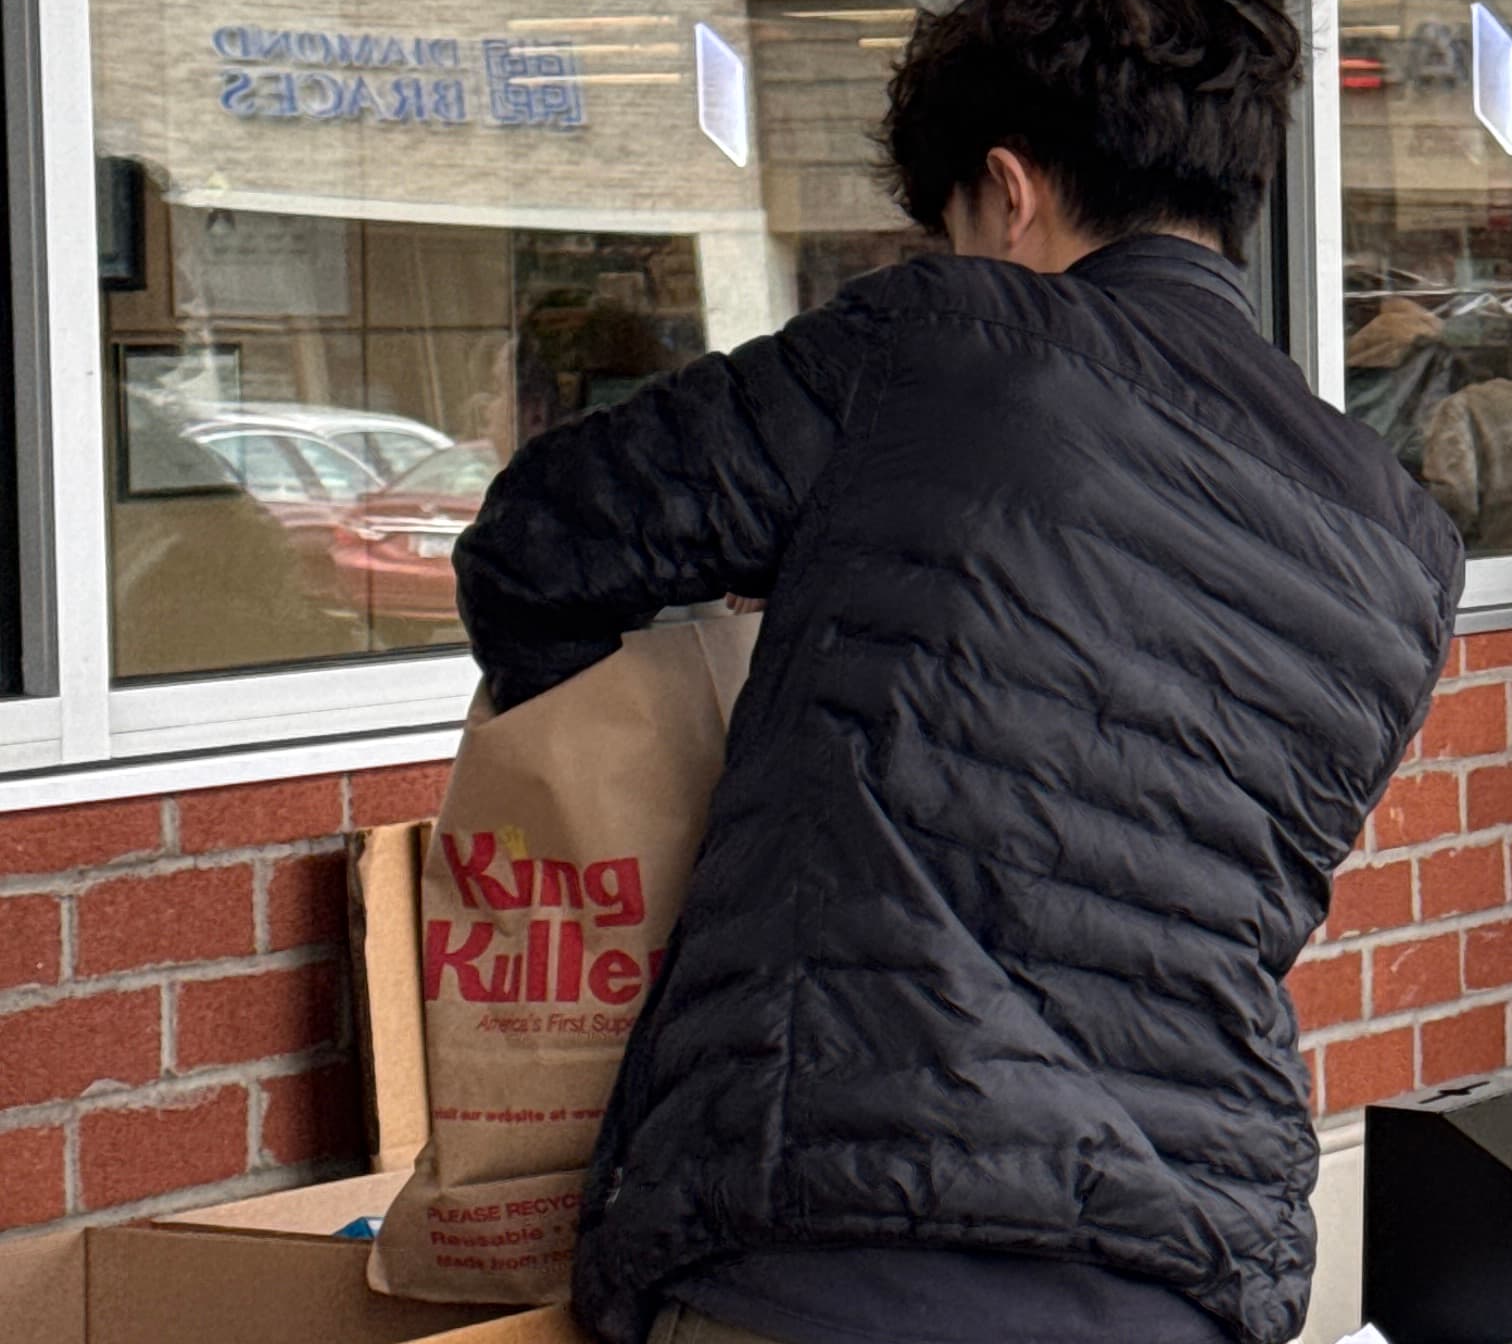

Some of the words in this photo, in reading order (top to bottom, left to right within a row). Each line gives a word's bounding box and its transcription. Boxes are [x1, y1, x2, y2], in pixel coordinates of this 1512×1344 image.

[440, 825, 644, 927] King
[547, 1014, 586, 1033] First
[427, 1205, 500, 1224] PLEASE
[430, 1227, 545, 1247] Reusable
